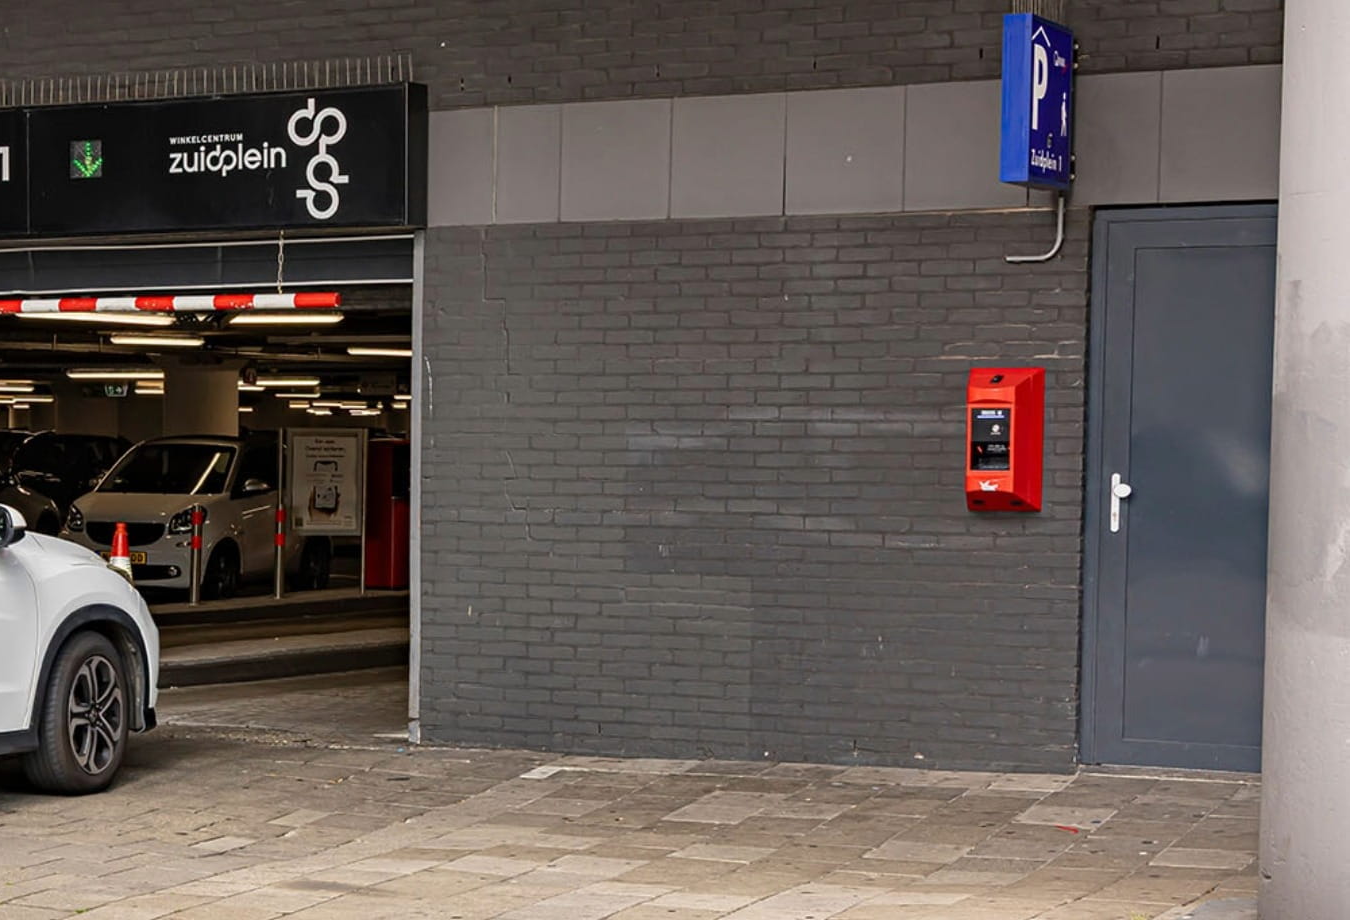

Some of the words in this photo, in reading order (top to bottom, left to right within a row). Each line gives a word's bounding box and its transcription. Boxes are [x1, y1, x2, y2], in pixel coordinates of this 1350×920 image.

[1031, 43, 1049, 130] P
[169, 133, 244, 145] WINKELCENTRUM
[169, 141, 288, 177] zuidplein
[1031, 148, 1057, 174] Zuidplein
